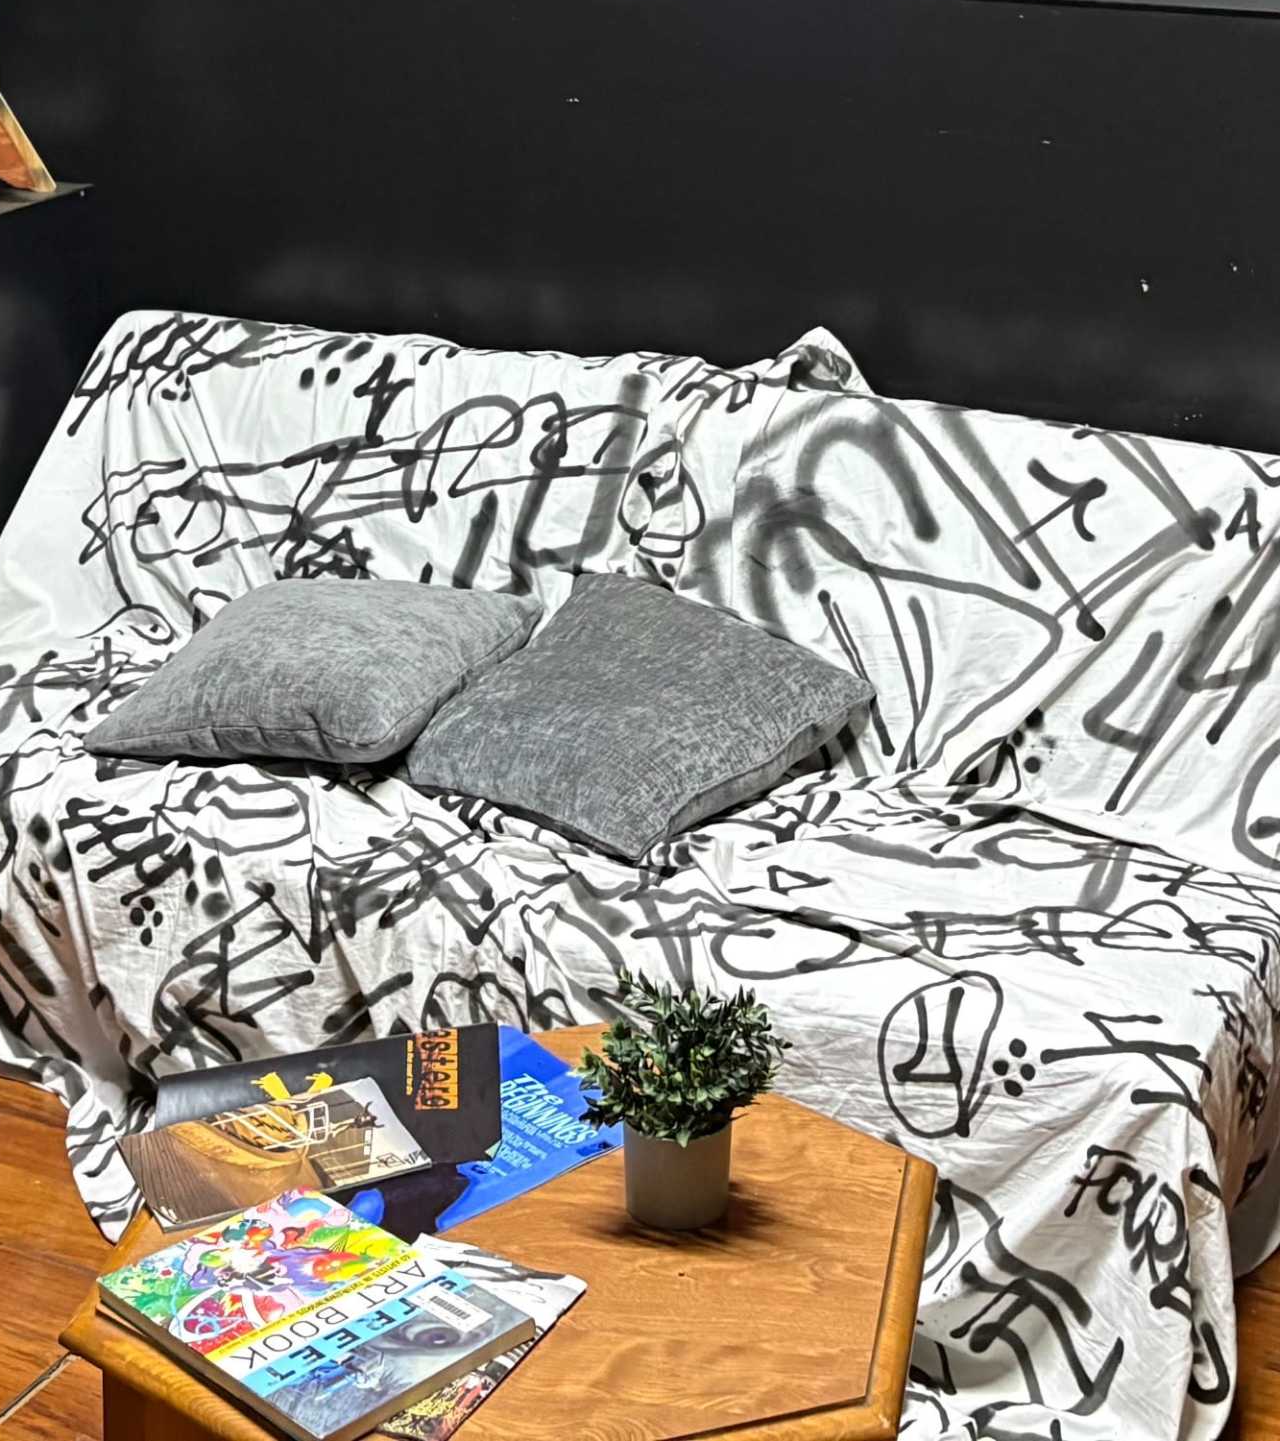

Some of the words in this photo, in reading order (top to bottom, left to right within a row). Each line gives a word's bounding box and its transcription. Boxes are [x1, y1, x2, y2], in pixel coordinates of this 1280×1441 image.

[513, 1073, 564, 1105] The
[356, 1260, 426, 1309] ART
[228, 1305, 349, 1369] BOOK
